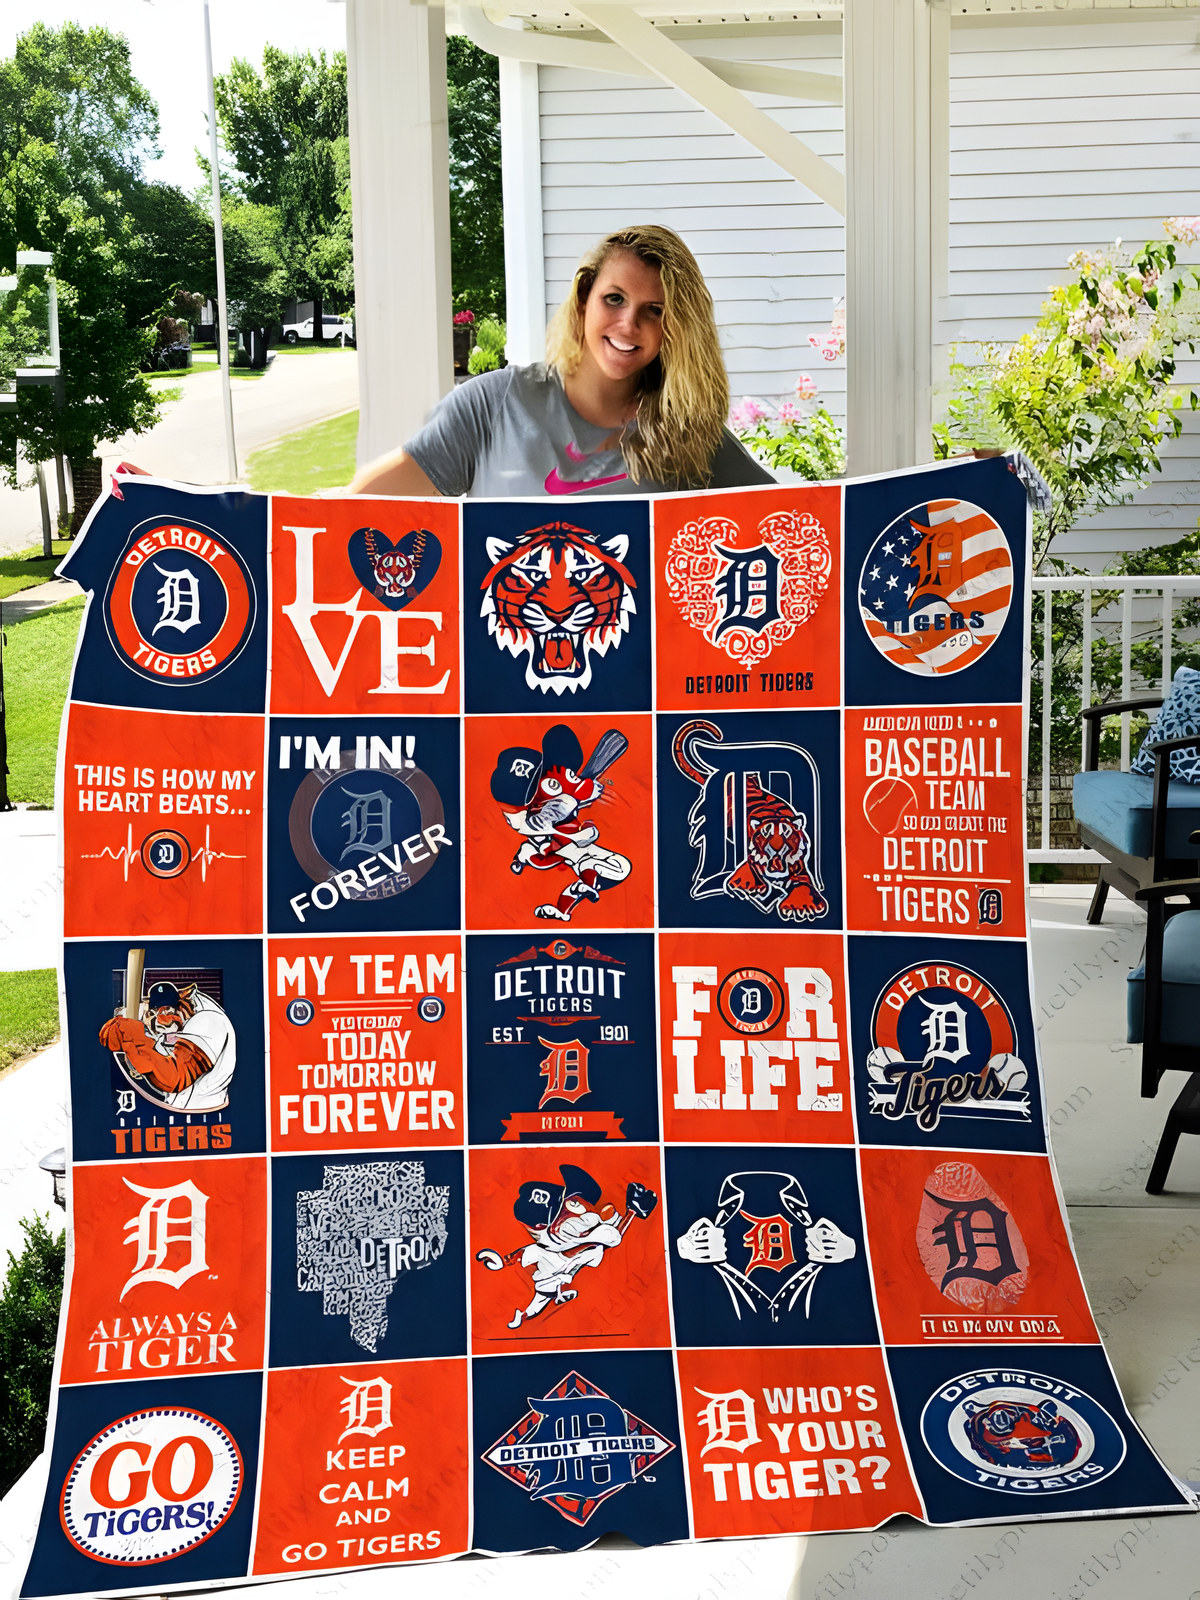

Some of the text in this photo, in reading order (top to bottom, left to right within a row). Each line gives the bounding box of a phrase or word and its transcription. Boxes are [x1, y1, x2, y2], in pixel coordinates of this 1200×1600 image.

[125, 528, 226, 567] DETROIT
[133, 641, 217, 676] TIGERS
[279, 735, 416, 770] I'M IN!
[865, 737, 1011, 777] BASEBALL
[74, 764, 256, 792] THIS IS HOW MY
[925, 780, 985, 811] TEAM
[79, 791, 251, 816] HEART BEATS...
[883, 836, 988, 873] DETROIT
[289, 822, 453, 923] FOREVER
[876, 886, 970, 925] TIGERS
[276, 953, 455, 997] MY TEAM
[494, 964, 626, 1001] DETROIT
[885, 967, 999, 1011] DETROIT
[528, 997, 592, 1014] TIGERS
[322, 1030, 412, 1062] TODAY
[492, 1025, 629, 1043] EST 1901
[298, 1060, 437, 1090] TOMORROW
[672, 1039, 843, 1112] LIFE
[279, 1090, 456, 1136] FOREVER
[882, 1060, 1010, 1132] Tigers
[111, 1124, 232, 1154] TIGERS
[89, 1311, 238, 1342] ALWAYS A
[88, 1333, 238, 1374] TIGER
[762, 1385, 878, 1415] WHO'S
[501, 1442, 580, 1462] DETROIT
[768, 1419, 887, 1454] YOUR
[90, 1435, 214, 1510] GO
[326, 1445, 406, 1471] KEEP
[319, 1477, 409, 1504] CALM
[703, 1455, 891, 1502] TIGER?
[976, 1462, 1105, 1490] TIGERS
[336, 1508, 391, 1527] AND
[282, 1530, 441, 1563] GO TIGERS
